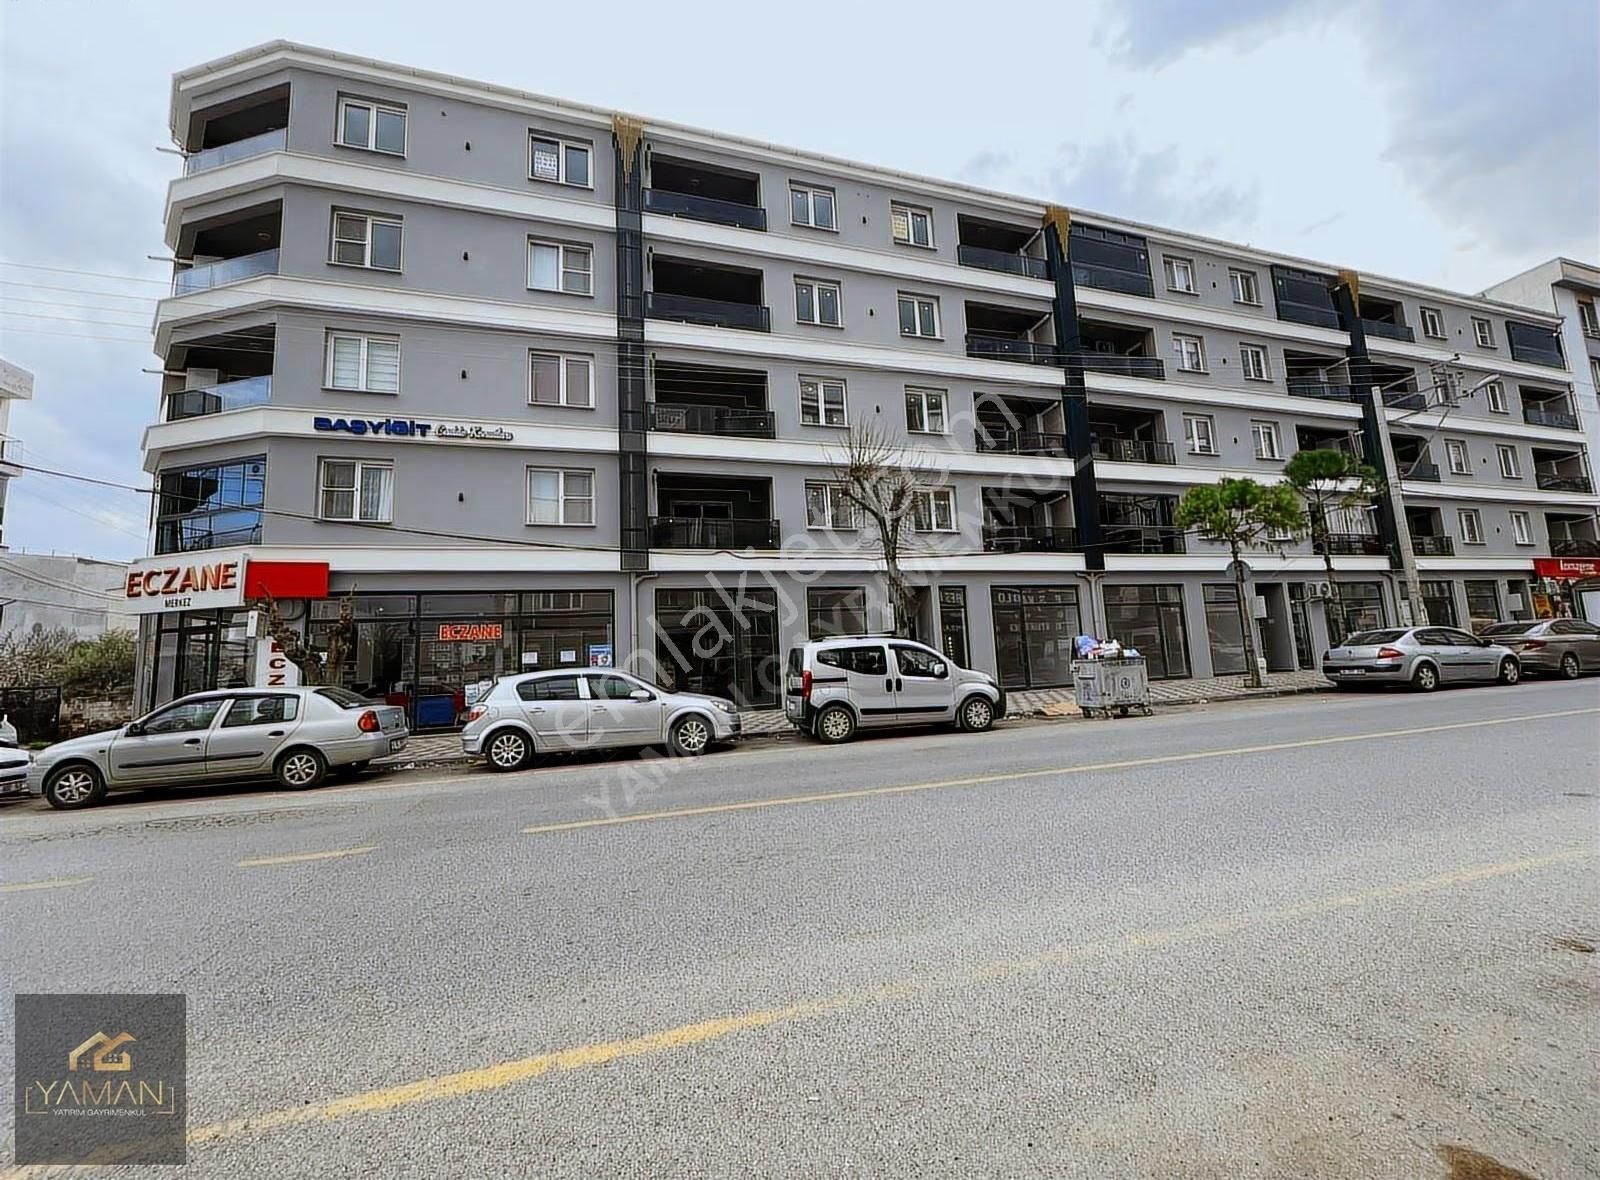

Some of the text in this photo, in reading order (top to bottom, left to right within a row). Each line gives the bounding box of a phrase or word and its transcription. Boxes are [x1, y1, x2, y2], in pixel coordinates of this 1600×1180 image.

[126, 561, 238, 598] ECZANE
[164, 597, 192, 608] MERKEZ
[439, 623, 502, 641] ECZANE
